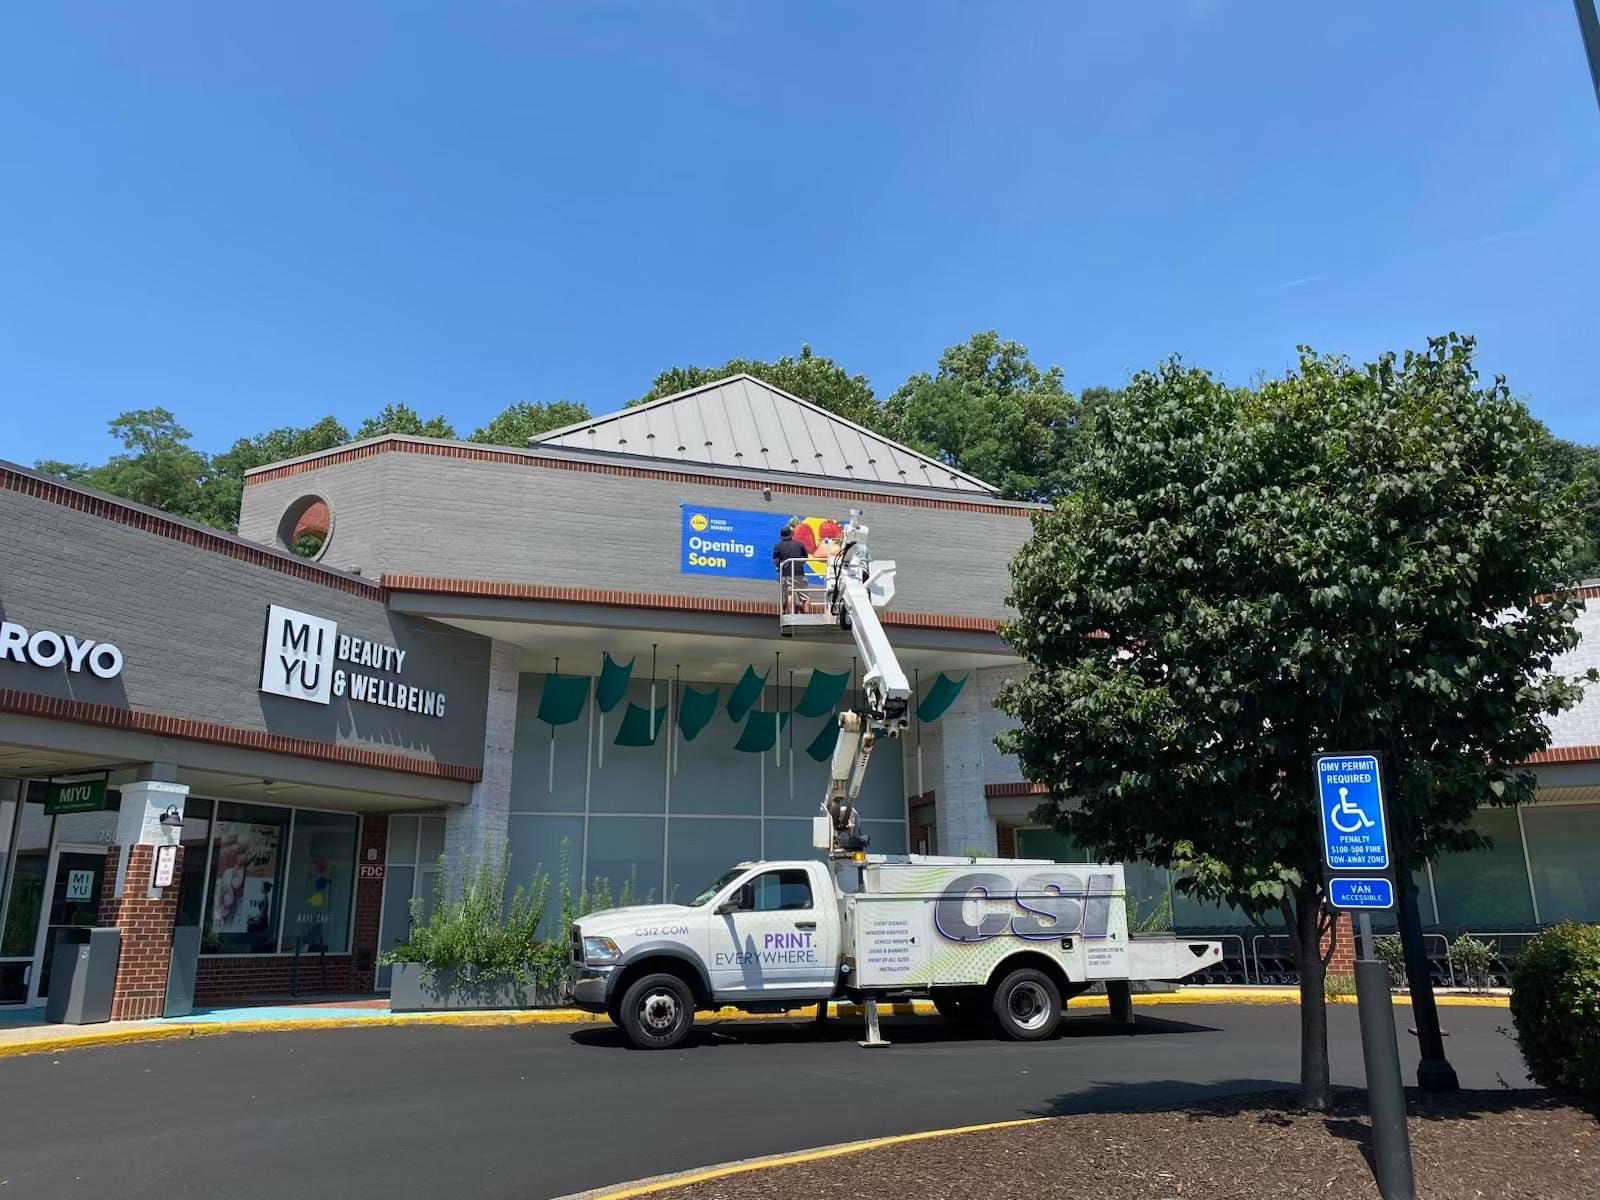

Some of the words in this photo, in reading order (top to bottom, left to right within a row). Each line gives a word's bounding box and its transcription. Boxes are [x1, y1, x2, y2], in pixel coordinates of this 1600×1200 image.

[689, 536, 754, 558] Opening
[689, 552, 727, 568] Soon
[282, 618, 324, 657] MI
[0, 621, 123, 679] ROYO
[338, 634, 407, 674] BEAUTY
[280, 655, 320, 691] YU
[332, 669, 347, 697] &
[350, 672, 446, 718] WELLBEING
[1320, 762, 1340, 772] DMV
[1341, 760, 1374, 771] PERMIT
[1326, 773, 1371, 785] REQUIRED
[59, 785, 91, 803] MIYU
[1339, 835, 1370, 843] PENALTY
[1331, 845, 1364, 854] $100-500
[1365, 845, 1382, 853] FINE
[1330, 855, 1366, 864] TOW-AWAY
[1367, 855, 1386, 864] ZONE
[360, 865, 383, 877] FDC
[73, 873, 89, 884] MI
[72, 885, 88, 896] YU
[1350, 884, 1372, 894] VAN
[1341, 894, 1383, 902] ACCESSIBLE
[935, 872, 1114, 942] CSI
